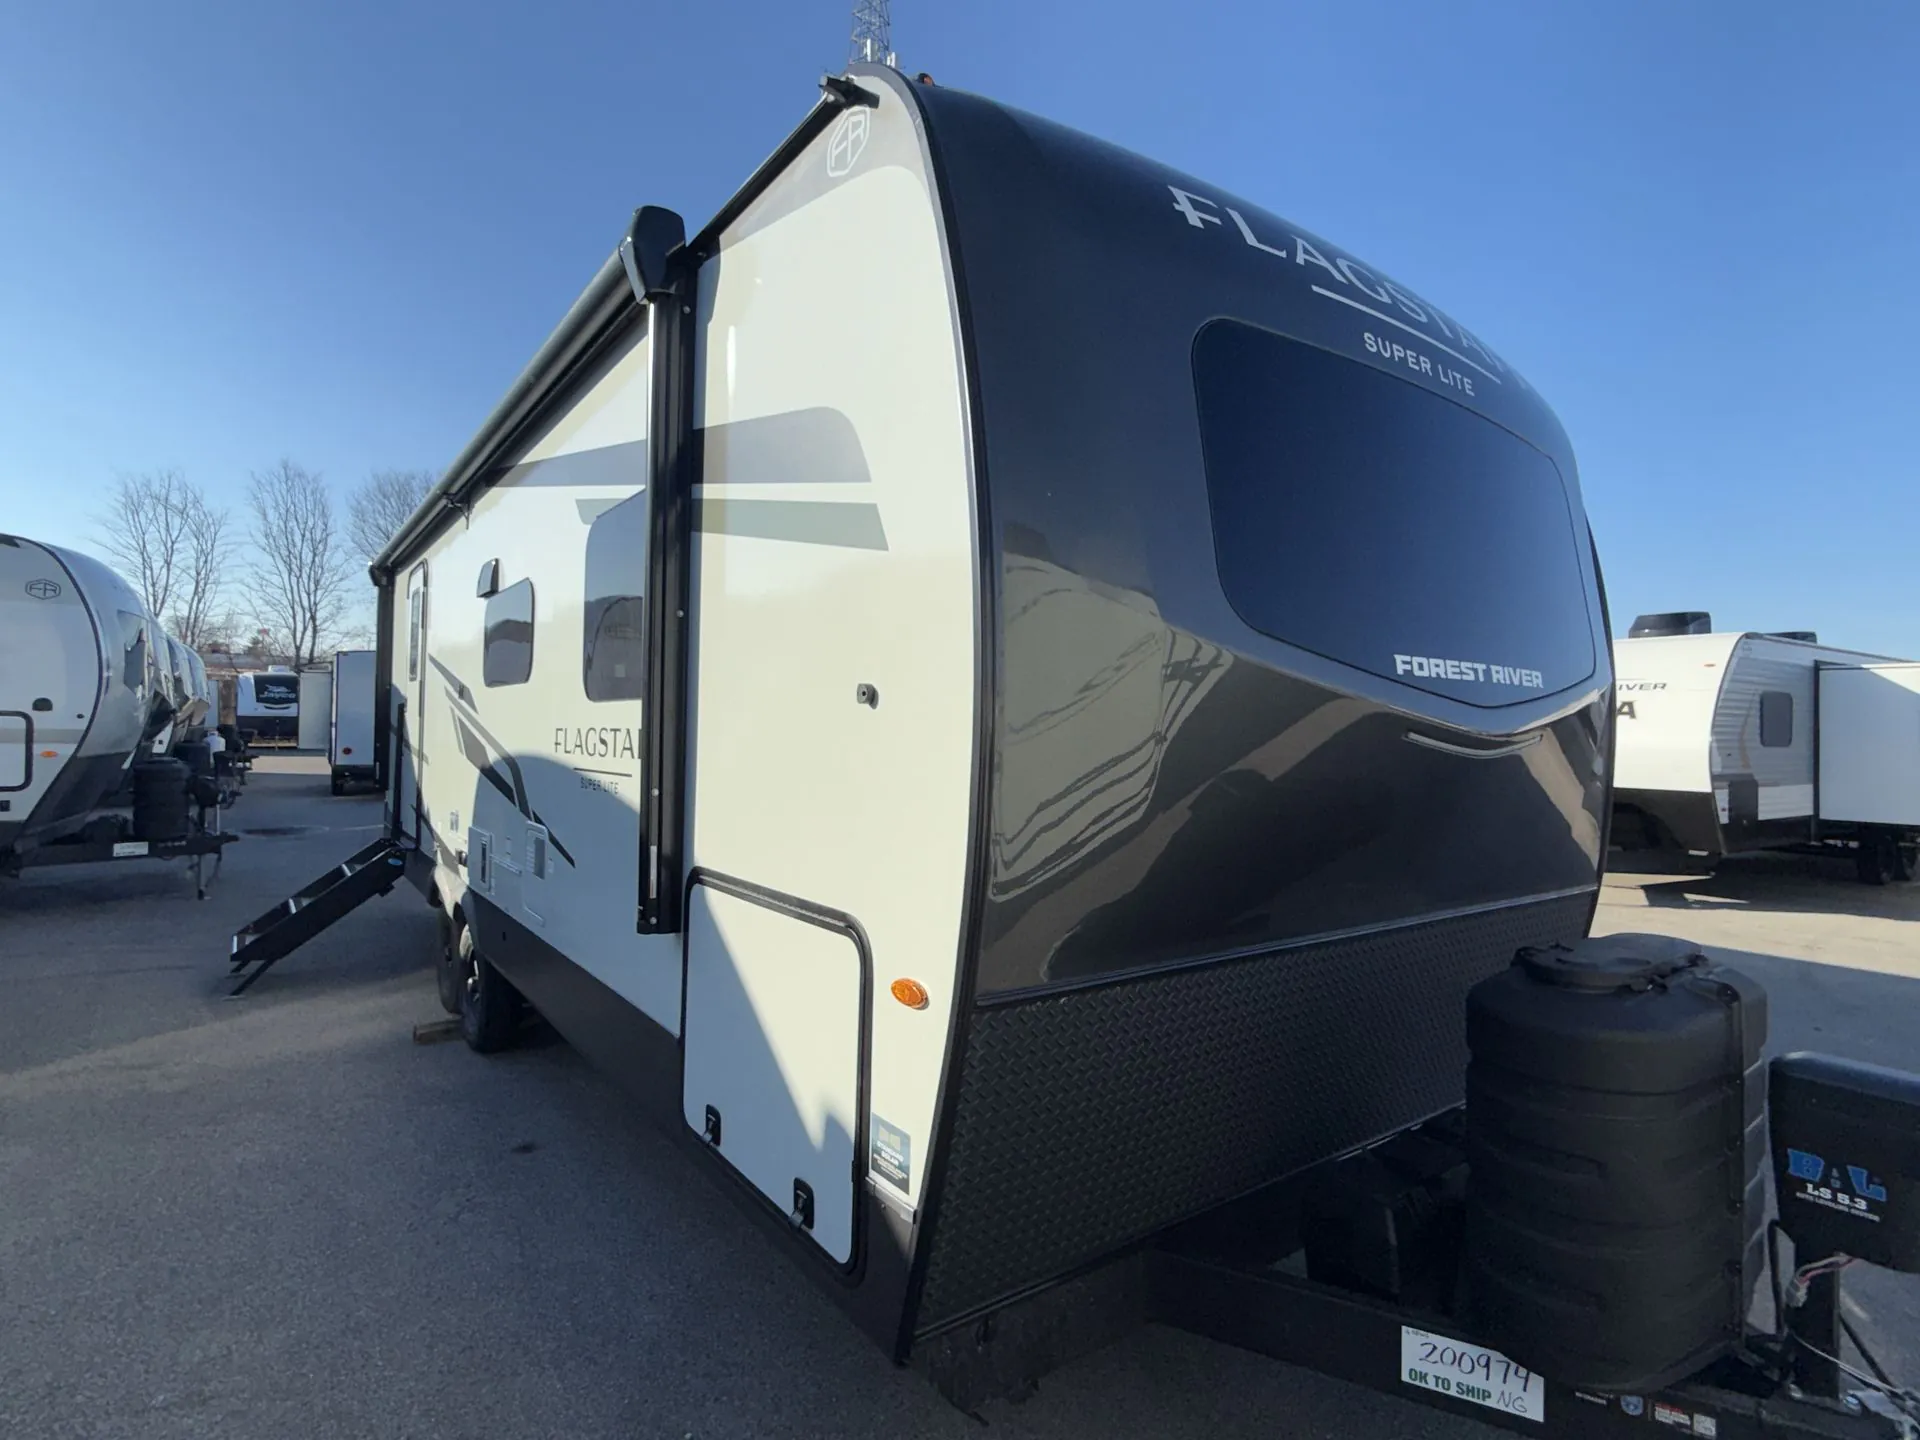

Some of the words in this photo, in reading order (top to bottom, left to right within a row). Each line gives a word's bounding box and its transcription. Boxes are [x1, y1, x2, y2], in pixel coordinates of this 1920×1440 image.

[1167, 184, 1527, 389] FLAGSTA
[1363, 331, 1432, 377] SUPER
[1437, 363, 1477, 397] LITE
[1393, 653, 1487, 682] FOREST
[1489, 665, 1544, 688] RIVER
[1617, 683, 1668, 693] IVER
[554, 727, 643, 760] FLAGSTA
[1805, 1182, 1833, 1200] LS
[1408, 1367, 1429, 1385] OK
[1433, 1374, 1451, 1392] TO
[1455, 1381, 1492, 1402] SHIP
[1418, 1341, 1532, 1393] 200974
